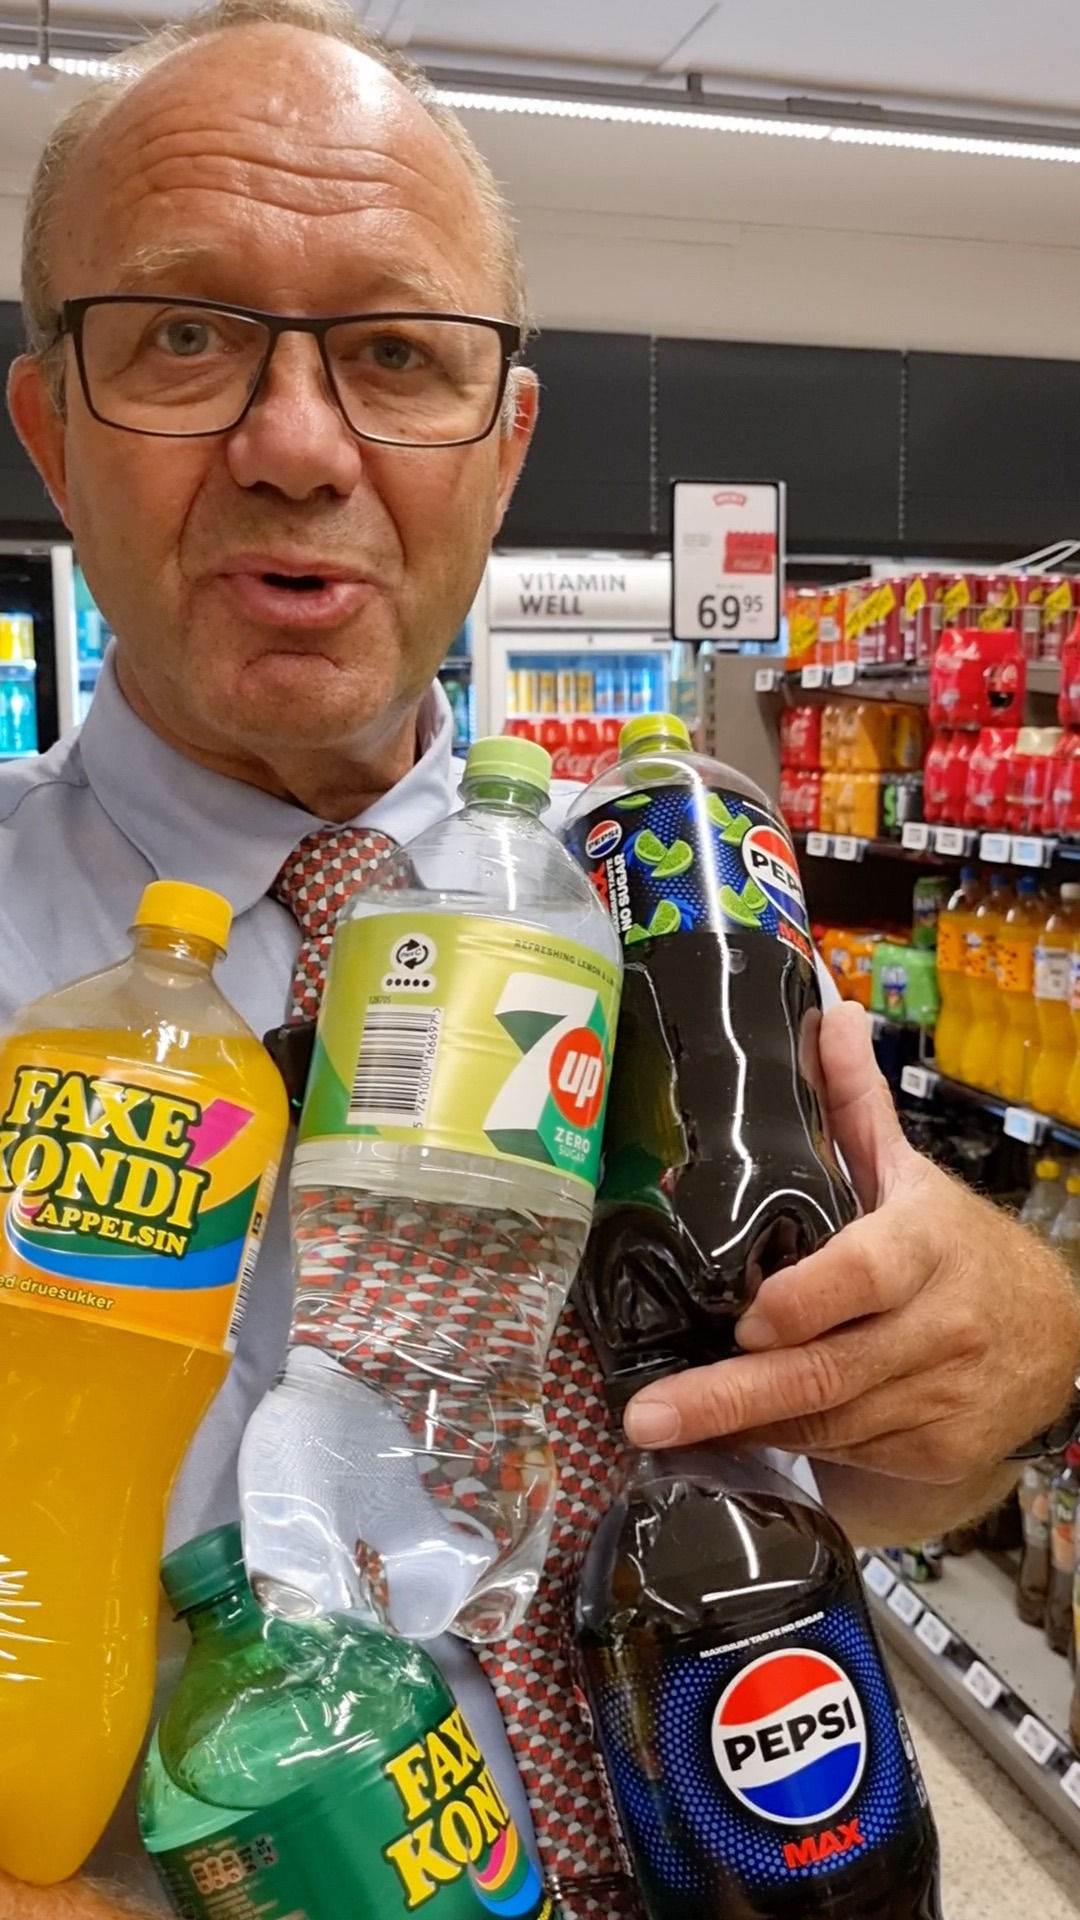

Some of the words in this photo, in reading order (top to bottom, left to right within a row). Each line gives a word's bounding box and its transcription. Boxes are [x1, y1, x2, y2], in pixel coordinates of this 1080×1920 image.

[519, 572, 626, 592] VITAMIN
[519, 595, 584, 615] WELL
[698, 594, 741, 630] 69
[743, 594, 763, 612] 95
[588, 827, 620, 850] PEPSI
[606, 858, 617, 890] TASTE
[613, 852, 630, 907] SUGAR
[620, 907, 633, 932] NO
[514, 939, 576, 964] REFRESHING
[577, 958, 601, 976] LEMON
[4, 1068, 199, 1160] FAXE
[554, 1126, 590, 1154] ZERO
[558, 1144, 586, 1163] SUGAR
[37, 1202, 189, 1257] APPELSIN
[19, 1278, 115, 1310] druesukker
[699, 1639, 750, 1659] MAXIMUM
[749, 1627, 781, 1645] TASTE
[780, 1622, 795, 1635] NO
[794, 1610, 825, 1629] SUGAR
[723, 1695, 857, 1773] PEPSI
[781, 1818, 866, 1870] MAX
